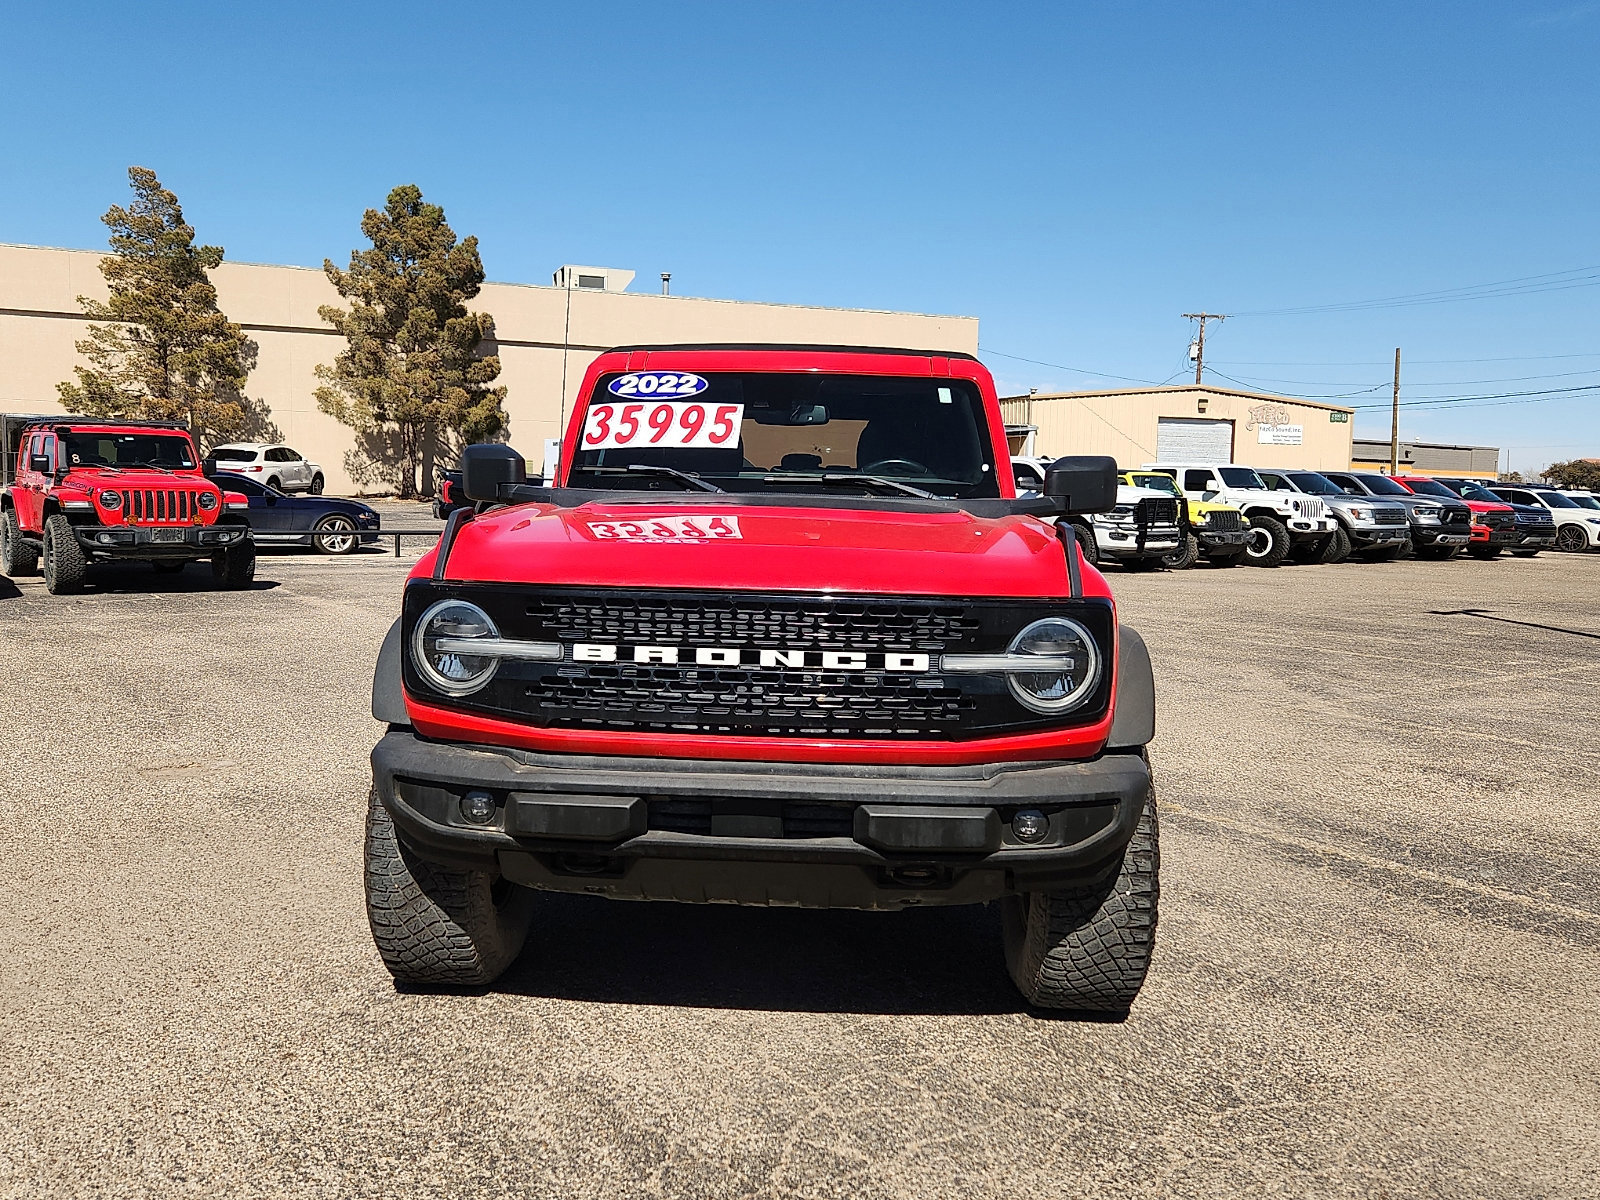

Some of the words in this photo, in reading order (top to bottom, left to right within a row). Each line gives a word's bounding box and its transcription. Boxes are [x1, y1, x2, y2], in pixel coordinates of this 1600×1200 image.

[617, 375, 699, 394] 2022
[585, 404, 738, 445] 35995
[572, 643, 930, 672] BRONCO
